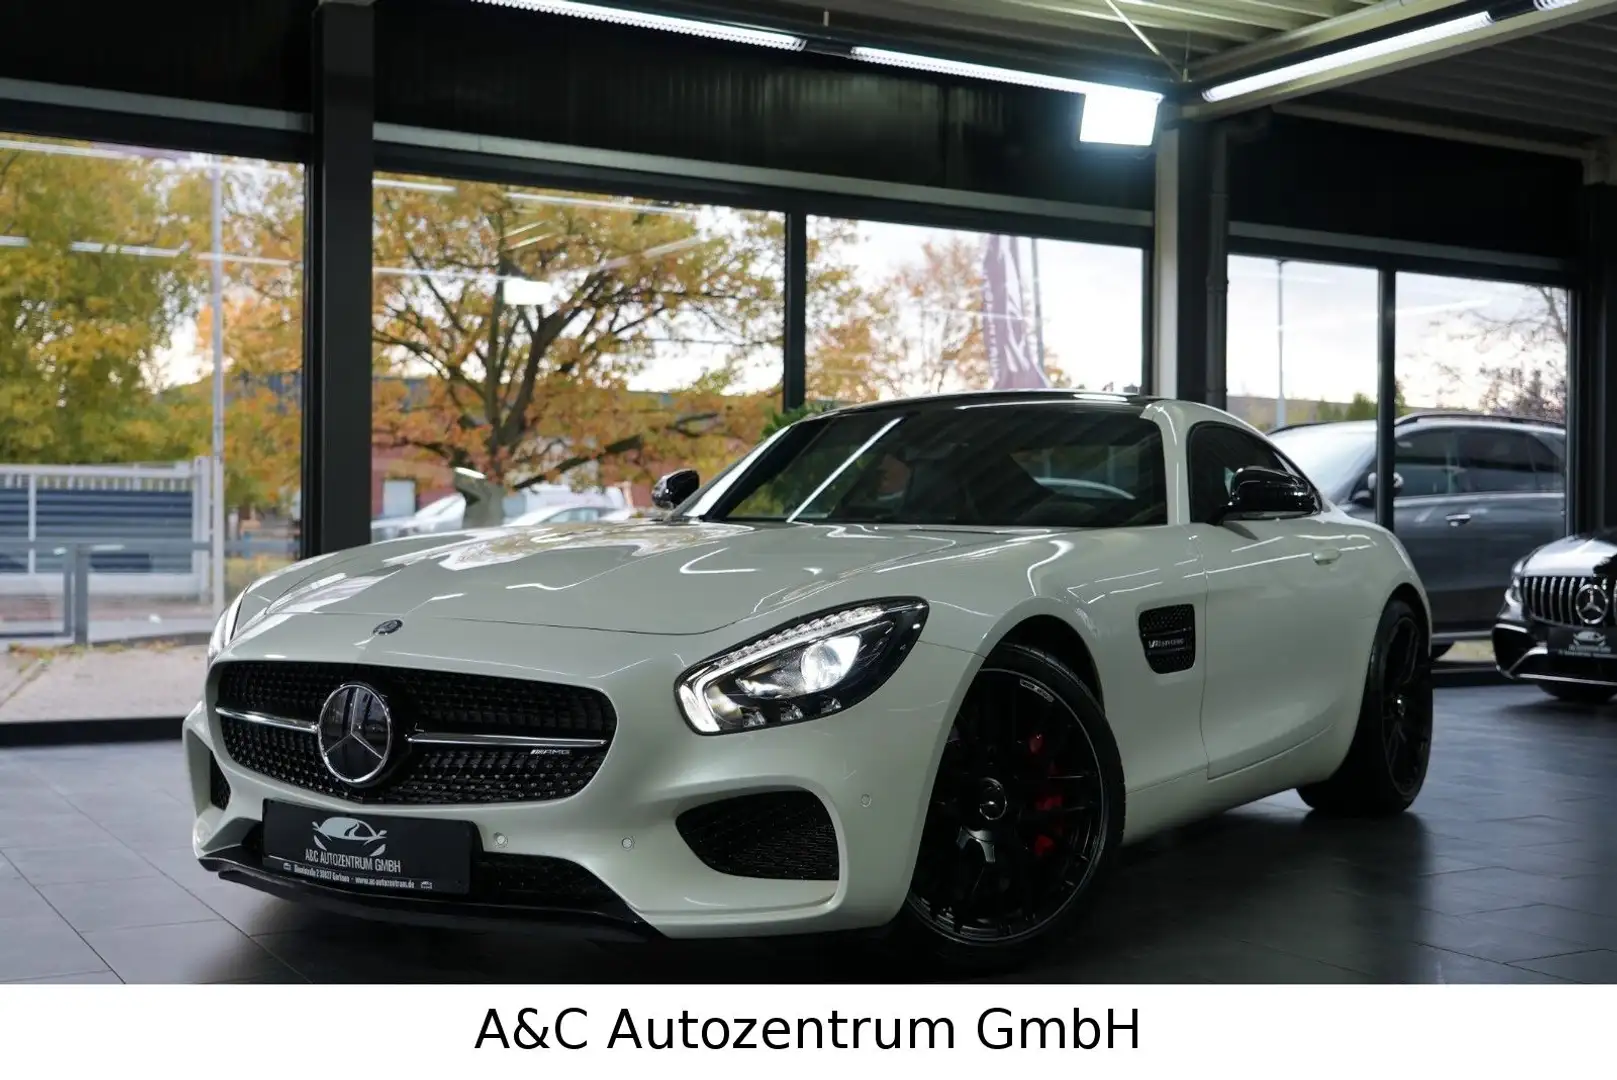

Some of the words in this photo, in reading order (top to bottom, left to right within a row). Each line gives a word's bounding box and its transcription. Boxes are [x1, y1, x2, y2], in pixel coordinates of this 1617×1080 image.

[305, 849, 319, 862] A&C
[320, 853, 373, 871] AUTOZENTRUM
[375, 859, 401, 873] GMBH
